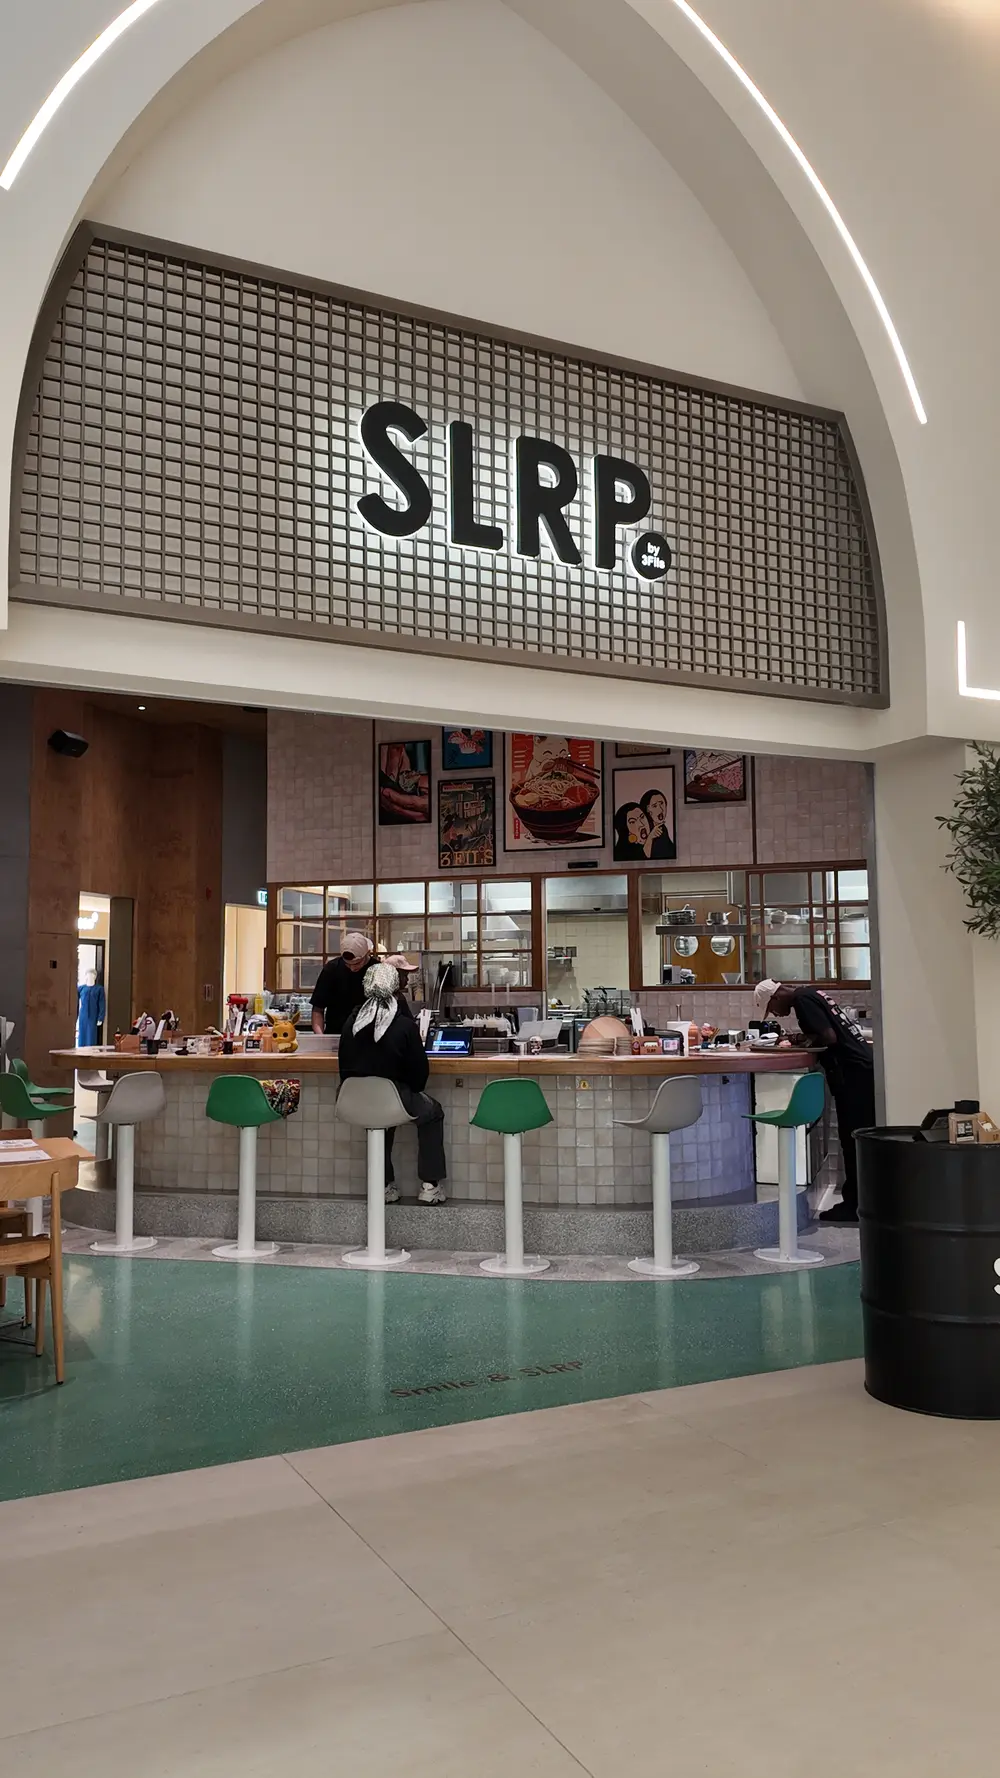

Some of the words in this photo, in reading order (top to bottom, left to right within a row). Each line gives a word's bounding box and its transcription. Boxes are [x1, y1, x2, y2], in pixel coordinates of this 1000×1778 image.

[357, 401, 651, 569] SLRP
[647, 542, 660, 557] by
[390, 1379, 478, 1398] Smile
[487, 1373, 514, 1383] &
[520, 1361, 583, 1377] SLRP
